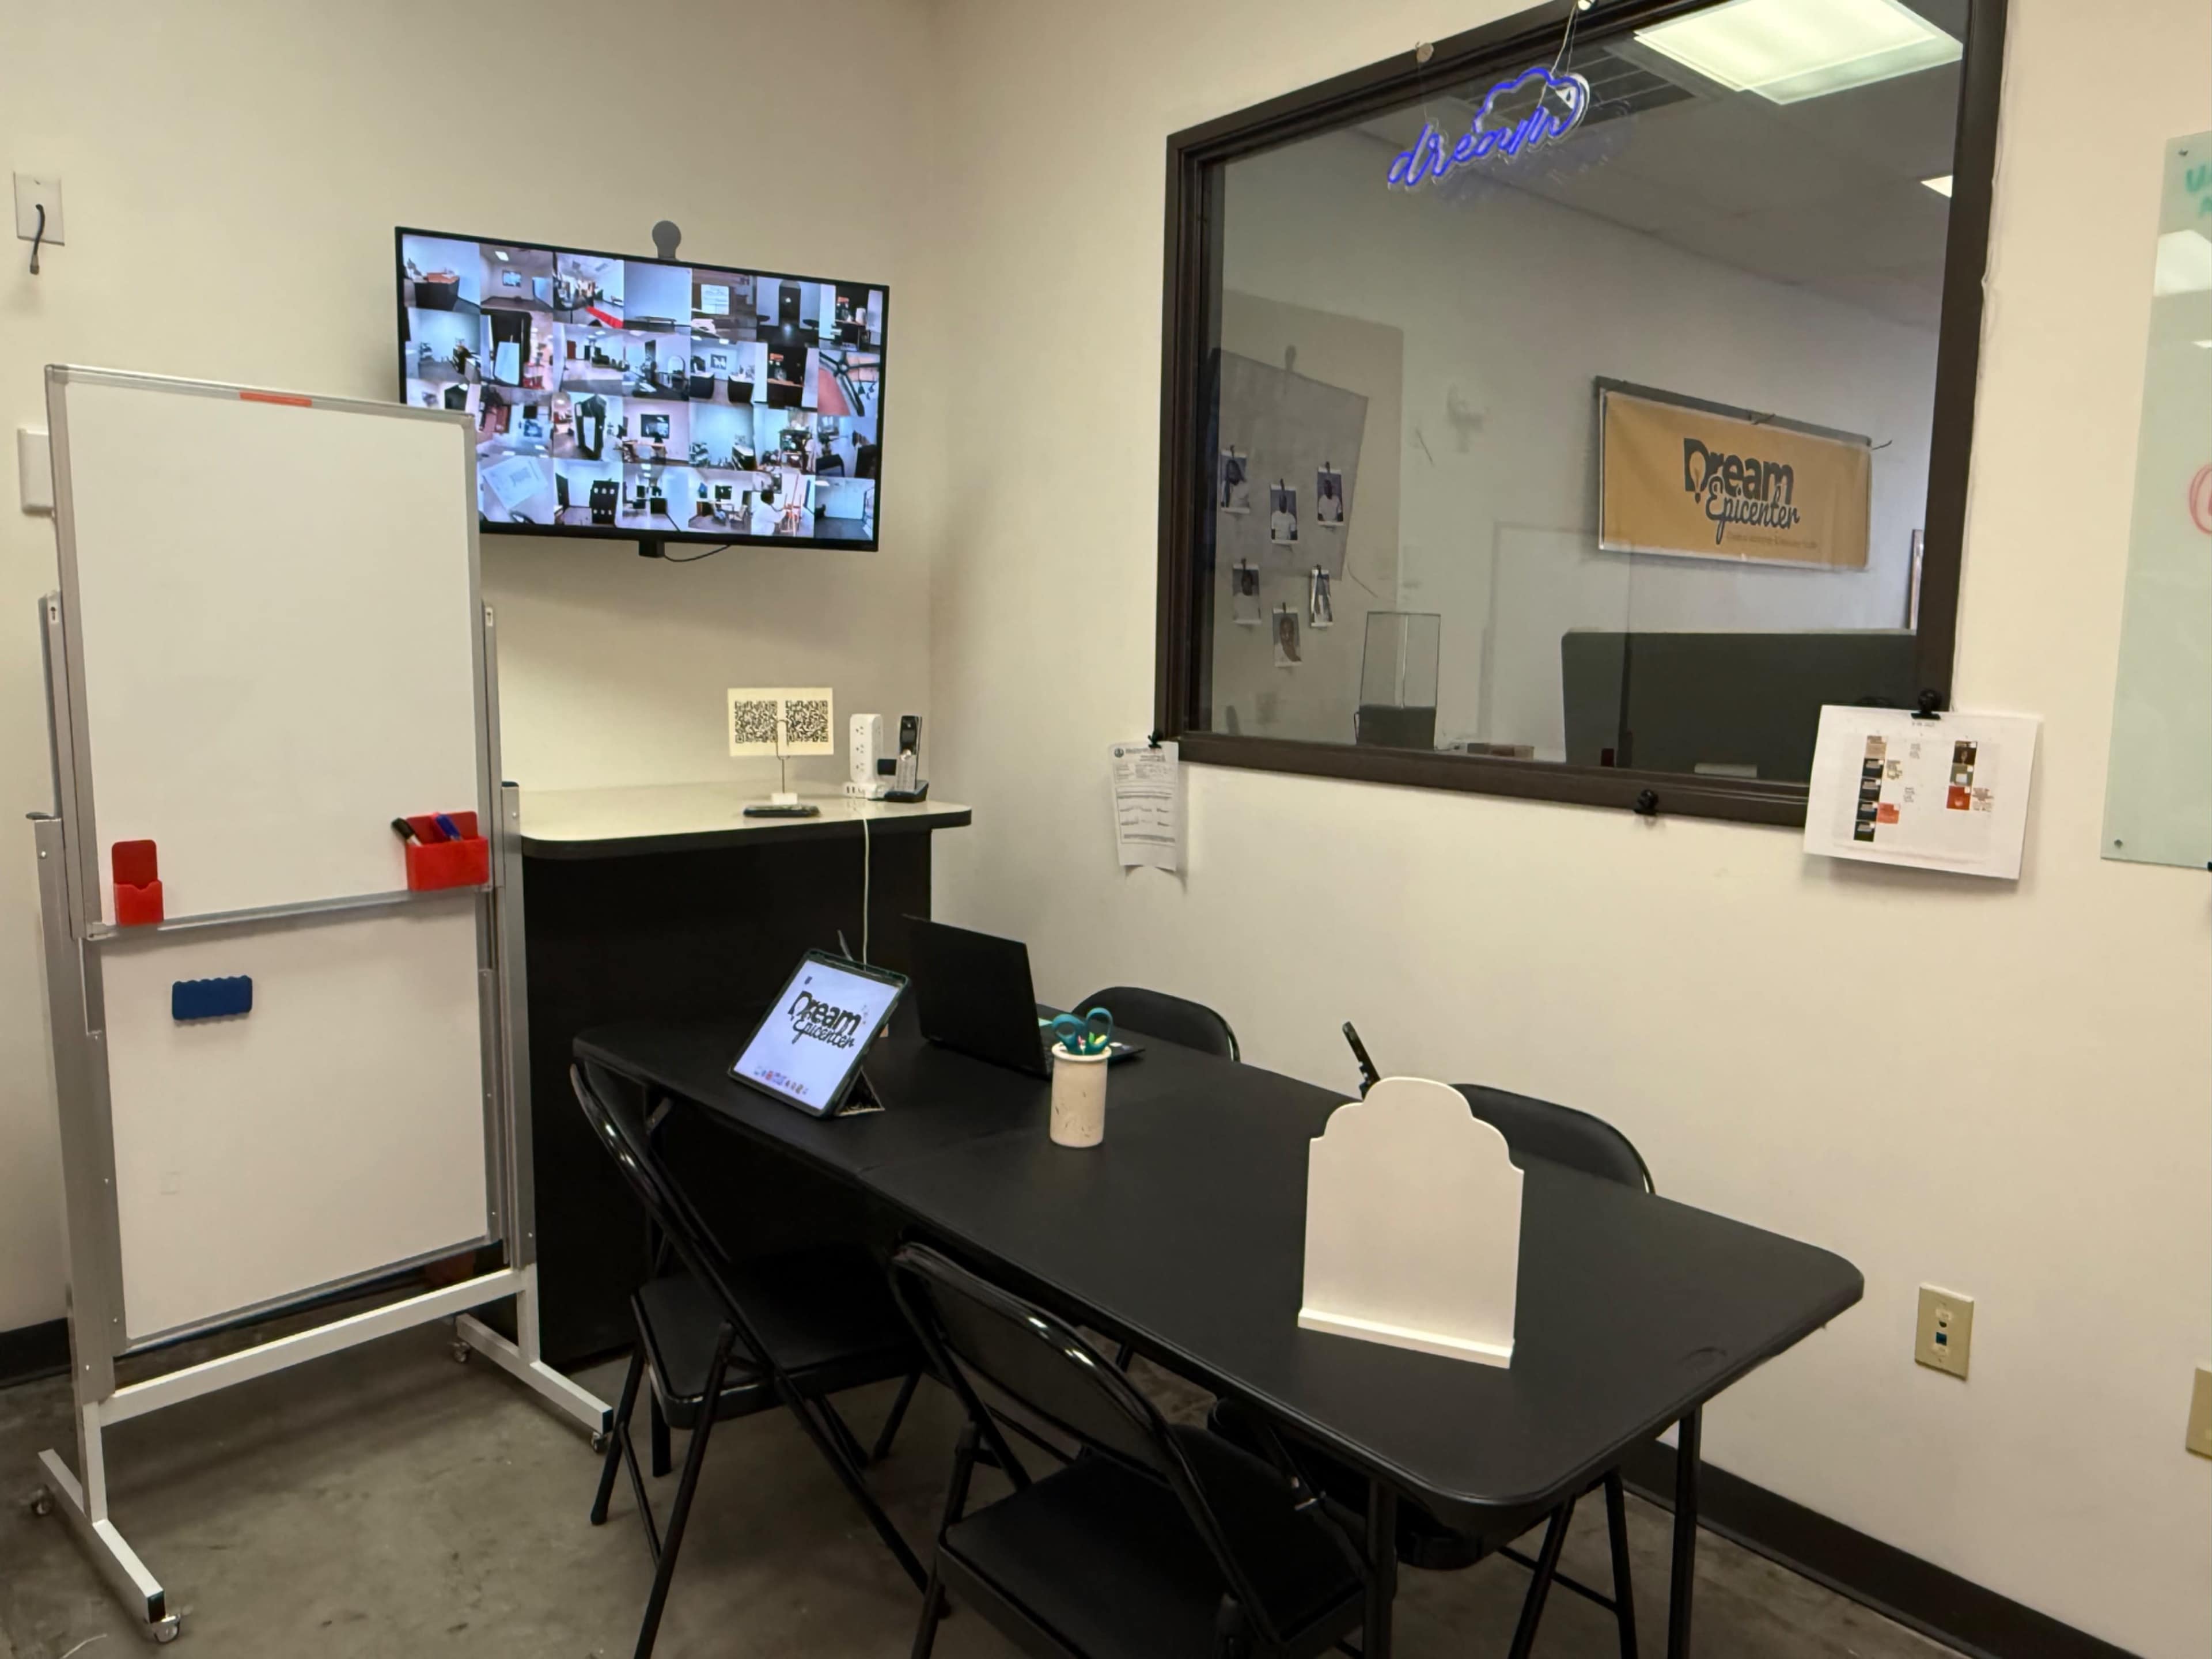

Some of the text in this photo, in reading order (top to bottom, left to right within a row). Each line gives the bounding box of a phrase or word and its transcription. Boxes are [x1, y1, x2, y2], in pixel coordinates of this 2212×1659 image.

[1388, 105, 1562, 186] dream
[1684, 438, 1794, 505] Dream
[1706, 476, 1800, 544] Epicenter
[787, 990, 862, 1036] Dream
[793, 1012, 855, 1049] Epicenter
